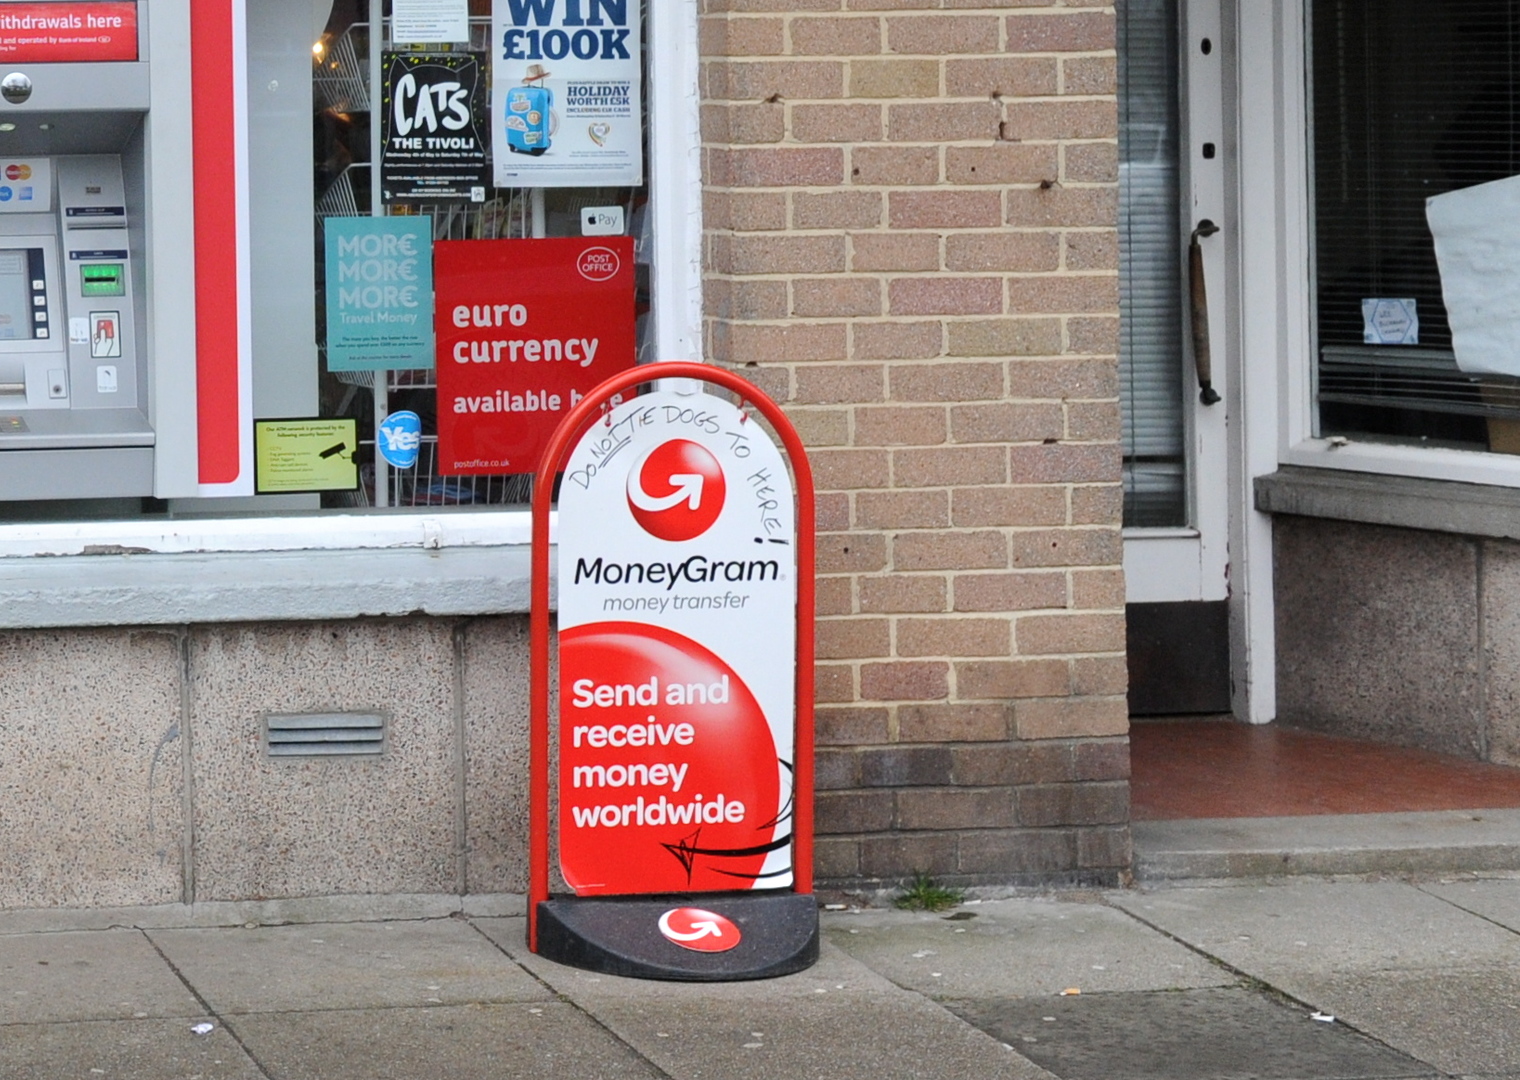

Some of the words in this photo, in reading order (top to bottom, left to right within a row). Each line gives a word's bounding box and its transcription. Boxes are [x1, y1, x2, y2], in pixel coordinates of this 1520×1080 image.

[87, 13, 122, 28] here
[503, 29, 630, 61] £100K
[566, 96, 608, 106] WORTH
[609, 96, 630, 106] £5K
[567, 86, 630, 97] HOLIDAY
[394, 73, 470, 136] CATS
[392, 137, 423, 150] THE
[425, 137, 475, 150] TIVOLI
[598, 213, 618, 227] Pay
[582, 262, 614, 273] OFFICE
[587, 254, 610, 264] POST
[340, 311, 375, 324] Travel
[377, 310, 418, 326] Money
[452, 302, 527, 328] euro
[453, 337, 599, 367] currency
[453, 389, 561, 415] available
[570, 388, 623, 411] he
[381, 426, 420, 451] Yes
[569, 463, 597, 490] DO
[590, 423, 621, 459] NOT
[661, 405, 720, 434] DOGS
[725, 431, 751, 459] TO
[453, 459, 510, 470] postoffice.co.uk
[573, 555, 780, 591] MoneyGram
[602, 593, 670, 614] money
[672, 591, 750, 610] transfer
[572, 675, 659, 708] Send
[665, 674, 730, 705] and
[572, 715, 696, 748] receive
[572, 761, 689, 792] money
[571, 793, 746, 828] worldwide
